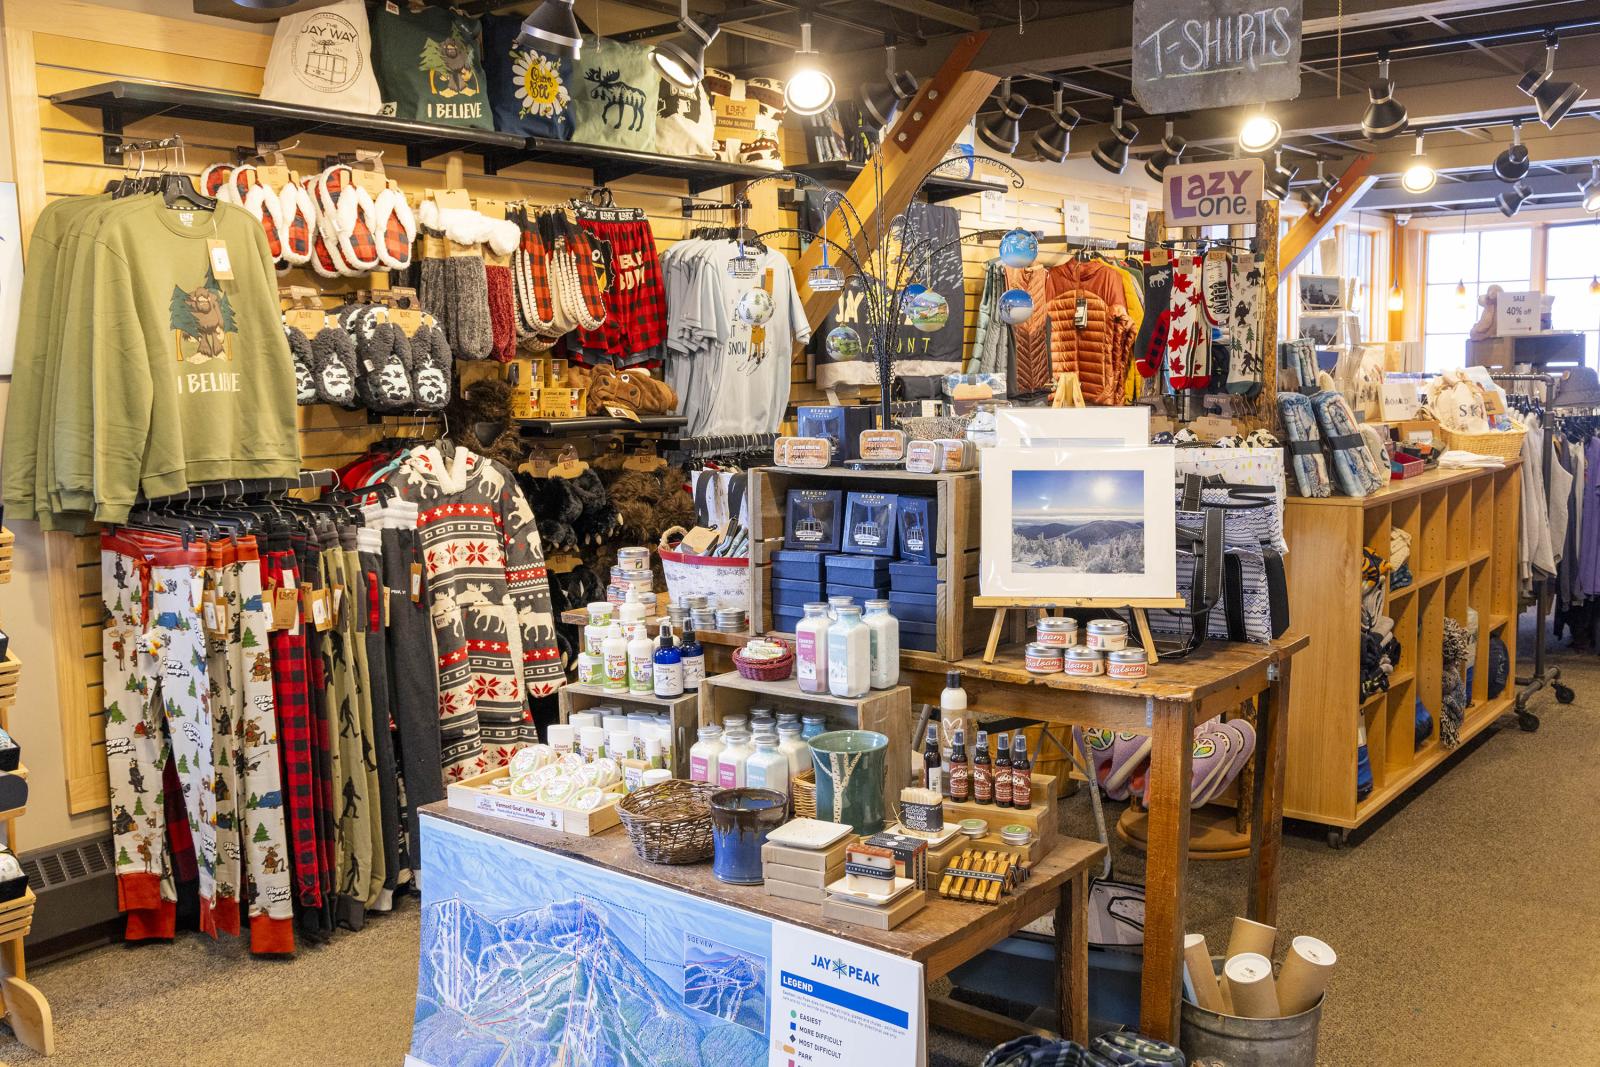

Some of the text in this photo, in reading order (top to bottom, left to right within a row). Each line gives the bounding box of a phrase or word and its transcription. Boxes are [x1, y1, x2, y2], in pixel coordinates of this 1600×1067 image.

[301, 25, 357, 43] JAY WAY
[1139, 6, 1291, 75] T-SHIRTS
[529, 81, 550, 99] Bee
[427, 102, 483, 119] I BELIEVE
[1506, 306, 1522, 316] 40%
[727, 340, 748, 356] SNOW
[177, 375, 183, 394] I
[106, 737, 130, 748] appy
[810, 954, 881, 987] JAY PEAK
[782, 974, 814, 993] LEGEND
[799, 1012, 822, 1026] EASIEST
[799, 1025, 843, 1047] MORE DIFFICULT
[798, 1038, 842, 1060] MOST DIFFICULT
[798, 1050, 813, 1062] PARK
